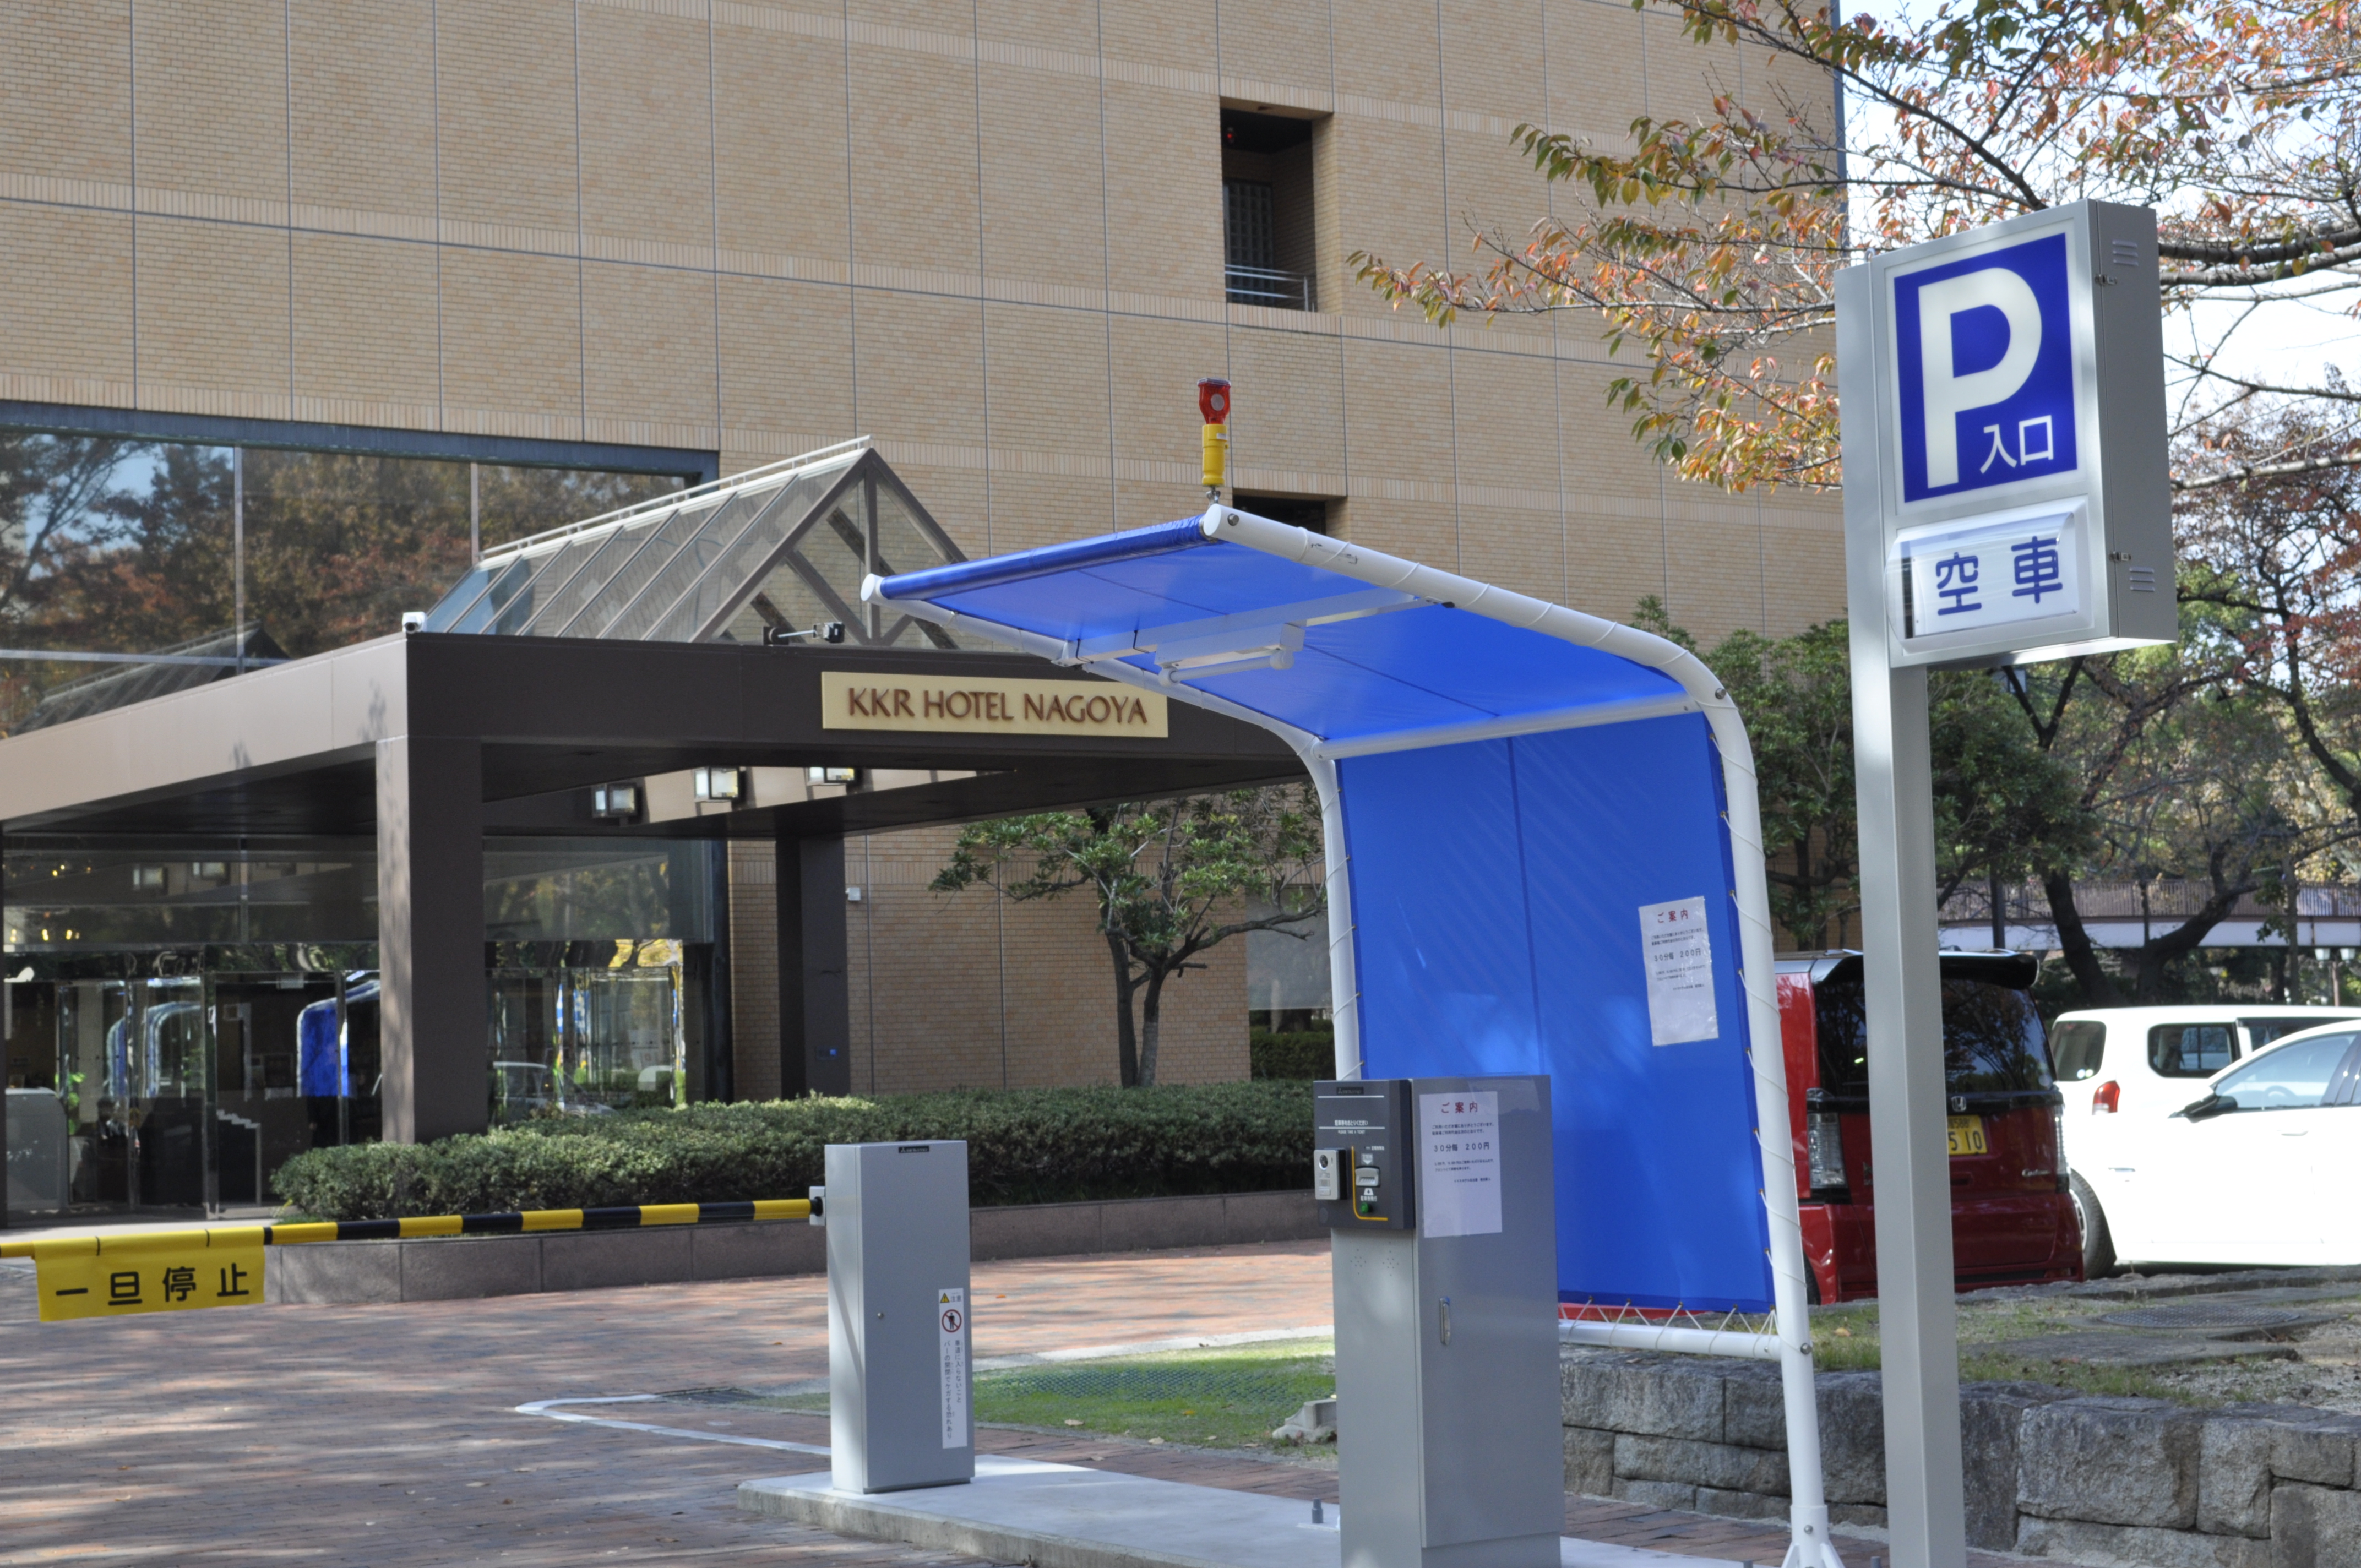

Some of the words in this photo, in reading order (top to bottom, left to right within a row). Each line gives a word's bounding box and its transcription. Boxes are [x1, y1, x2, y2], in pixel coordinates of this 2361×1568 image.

[1918, 268, 2042, 489] P
[1979, 415, 2054, 473] 入口
[1936, 536, 2063, 616] 空車
[848, 687, 916, 717] KKR
[923, 690, 1015, 720] HOTEL
[1023, 693, 1148, 724] NAGOYA
[1657, 909, 1689, 923] ご案内
[1680, 948, 1701, 958] 200円
[1441, 1101, 1478, 1114] ご案内
[1434, 1144, 1458, 1152] 30分毎
[1465, 1142, 1490, 1150] 200円
[56, 1263, 250, 1306] 一旦停止
